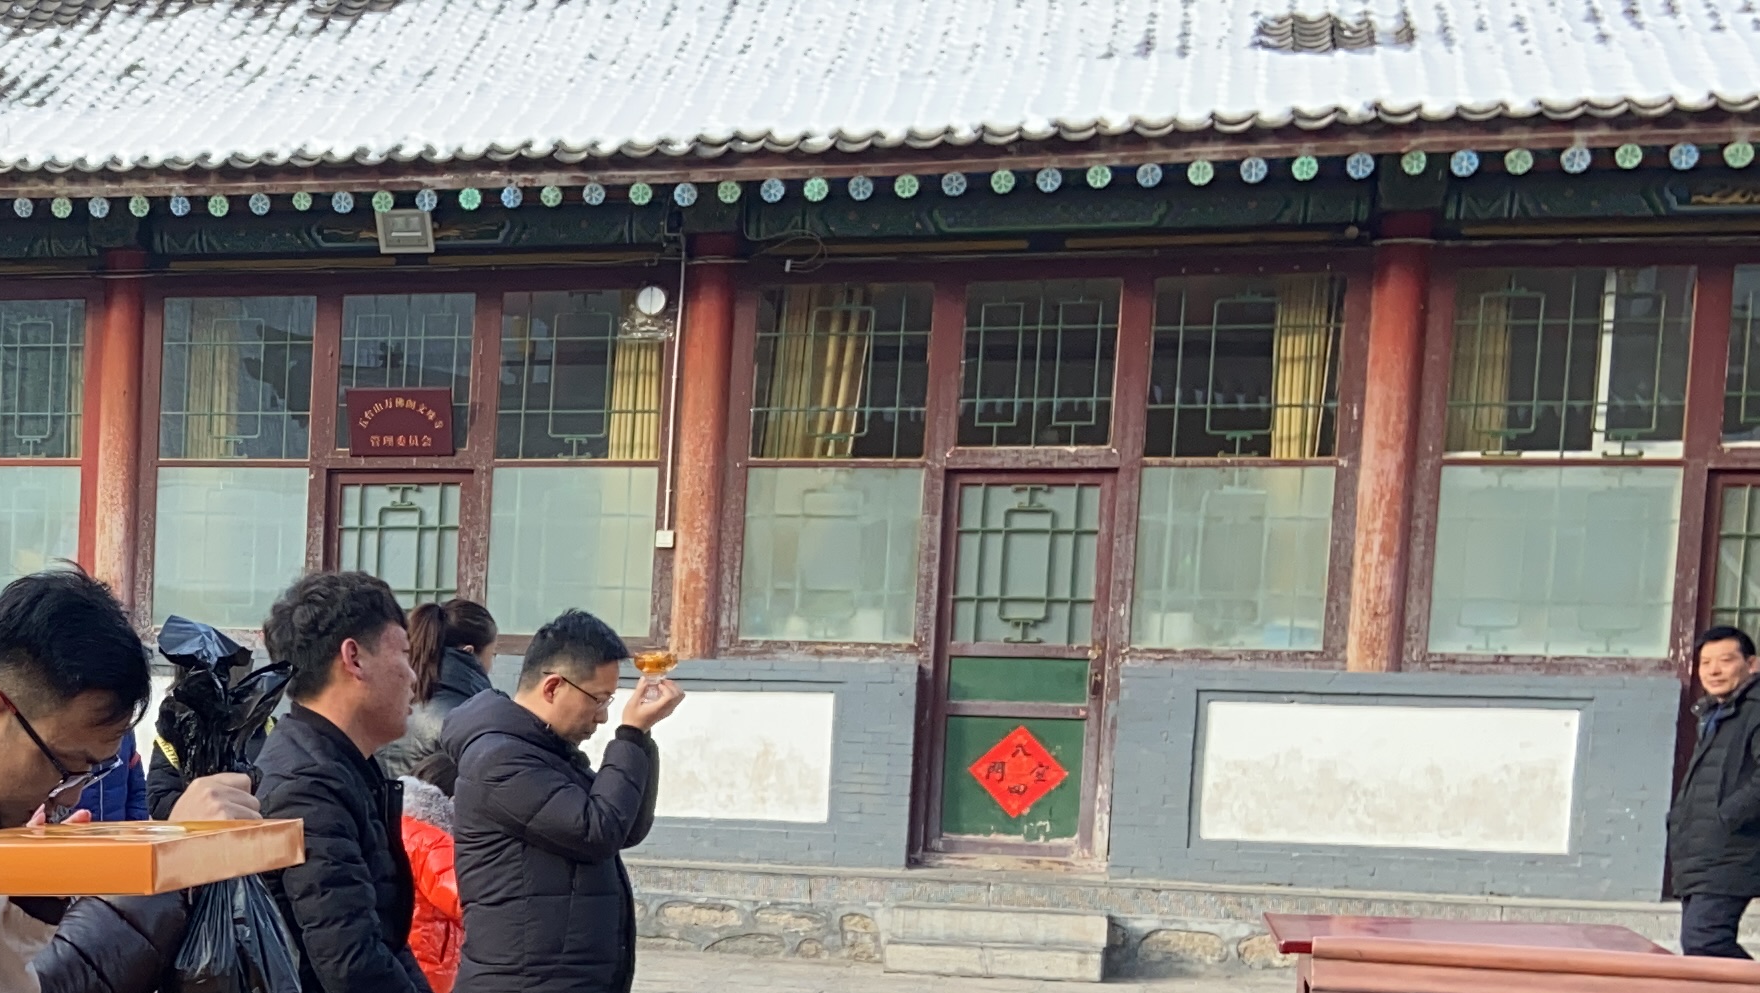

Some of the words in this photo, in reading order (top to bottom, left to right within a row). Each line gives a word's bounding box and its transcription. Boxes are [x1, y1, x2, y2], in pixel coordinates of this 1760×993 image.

[369, 435, 433, 447] 管理委员会
